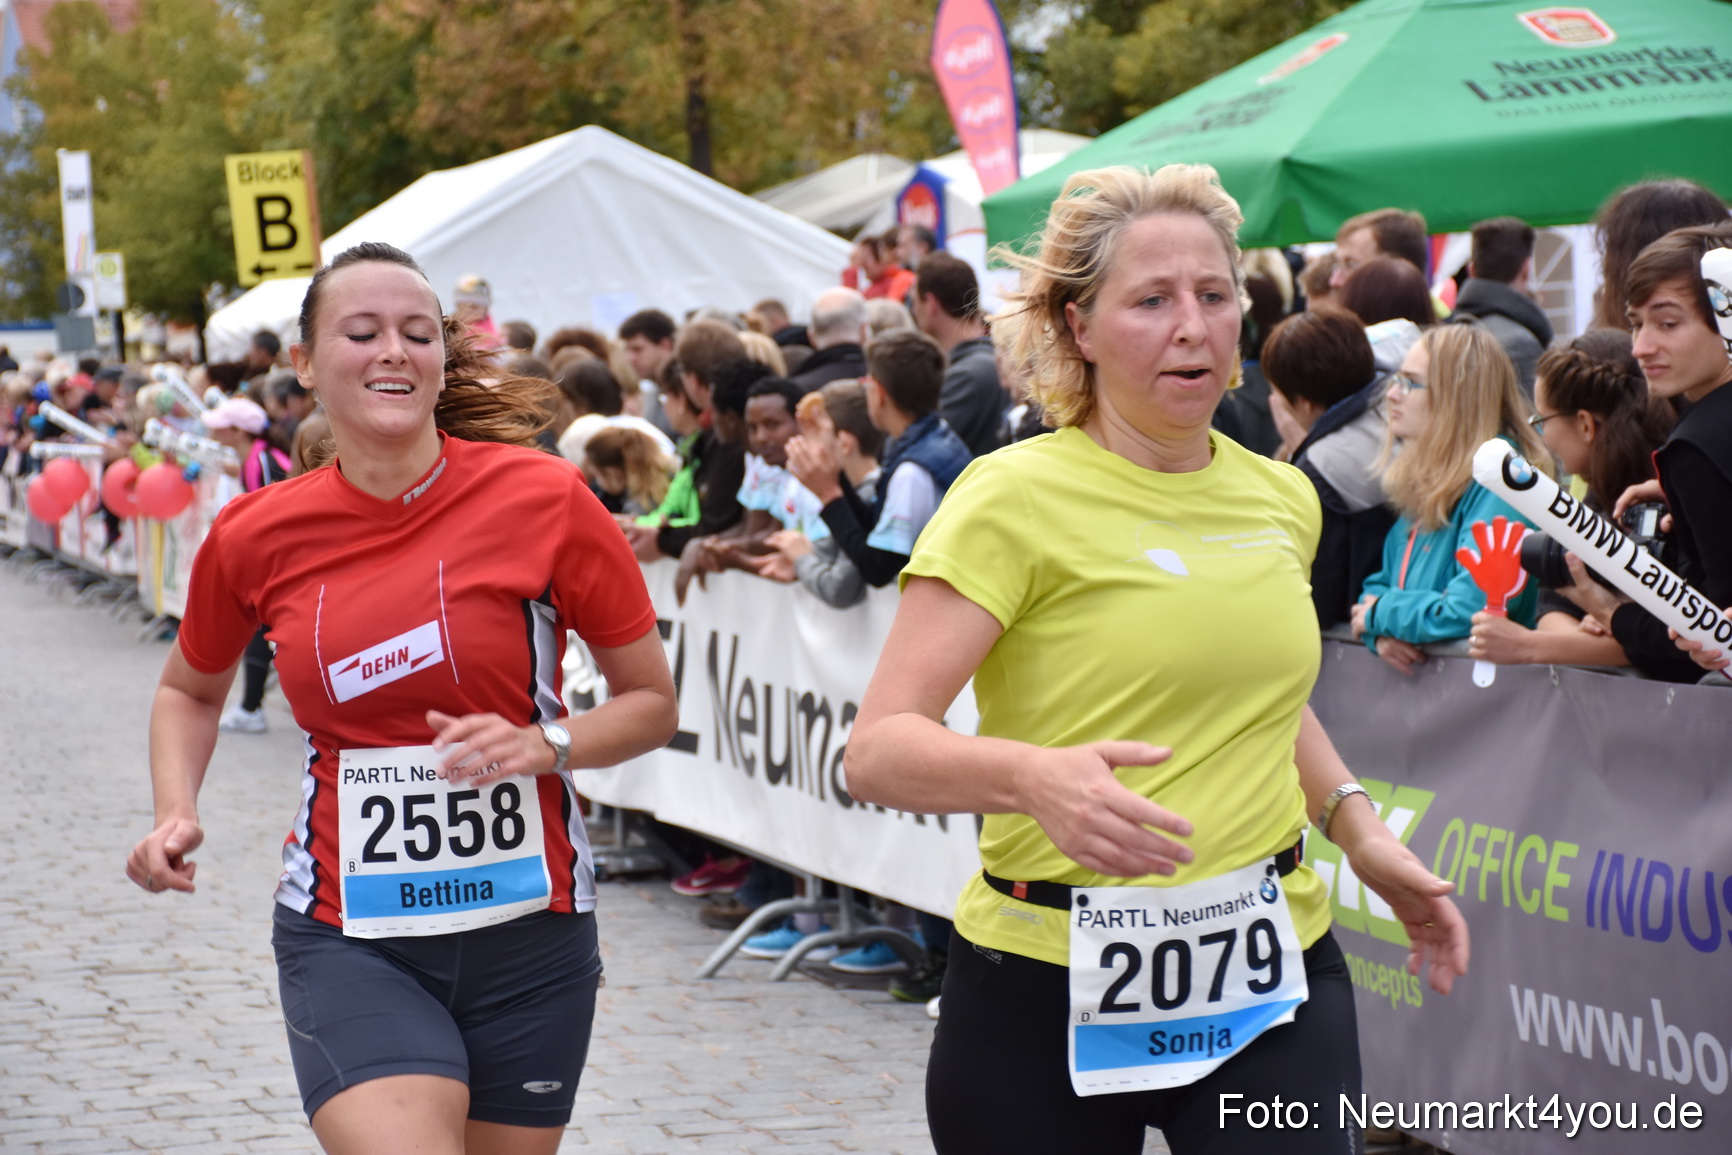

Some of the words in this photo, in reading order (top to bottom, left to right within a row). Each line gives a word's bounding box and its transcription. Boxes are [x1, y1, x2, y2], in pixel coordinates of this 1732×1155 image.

[1491, 46, 1718, 77] Neumarkter
[238, 159, 304, 184] Block
[255, 194, 298, 252] B
[1547, 487, 1626, 558] BMW
[1623, 542, 1732, 651] Laufspo
[362, 645, 409, 681] DEHN
[344, 766, 405, 784] PARTL
[361, 782, 526, 863] 2558
[348, 861, 356, 873] B
[1433, 817, 1579, 922] OFFICE
[400, 879, 494, 908] Bettina
[1078, 909, 1156, 928] PARTL
[1163, 892, 1257, 926] Neumarkt
[1098, 918, 1282, 1014] 2079
[1081, 1012, 1091, 1023] D
[1149, 1025, 1232, 1057] Sonja
[1509, 984, 1732, 1096] www.bo
